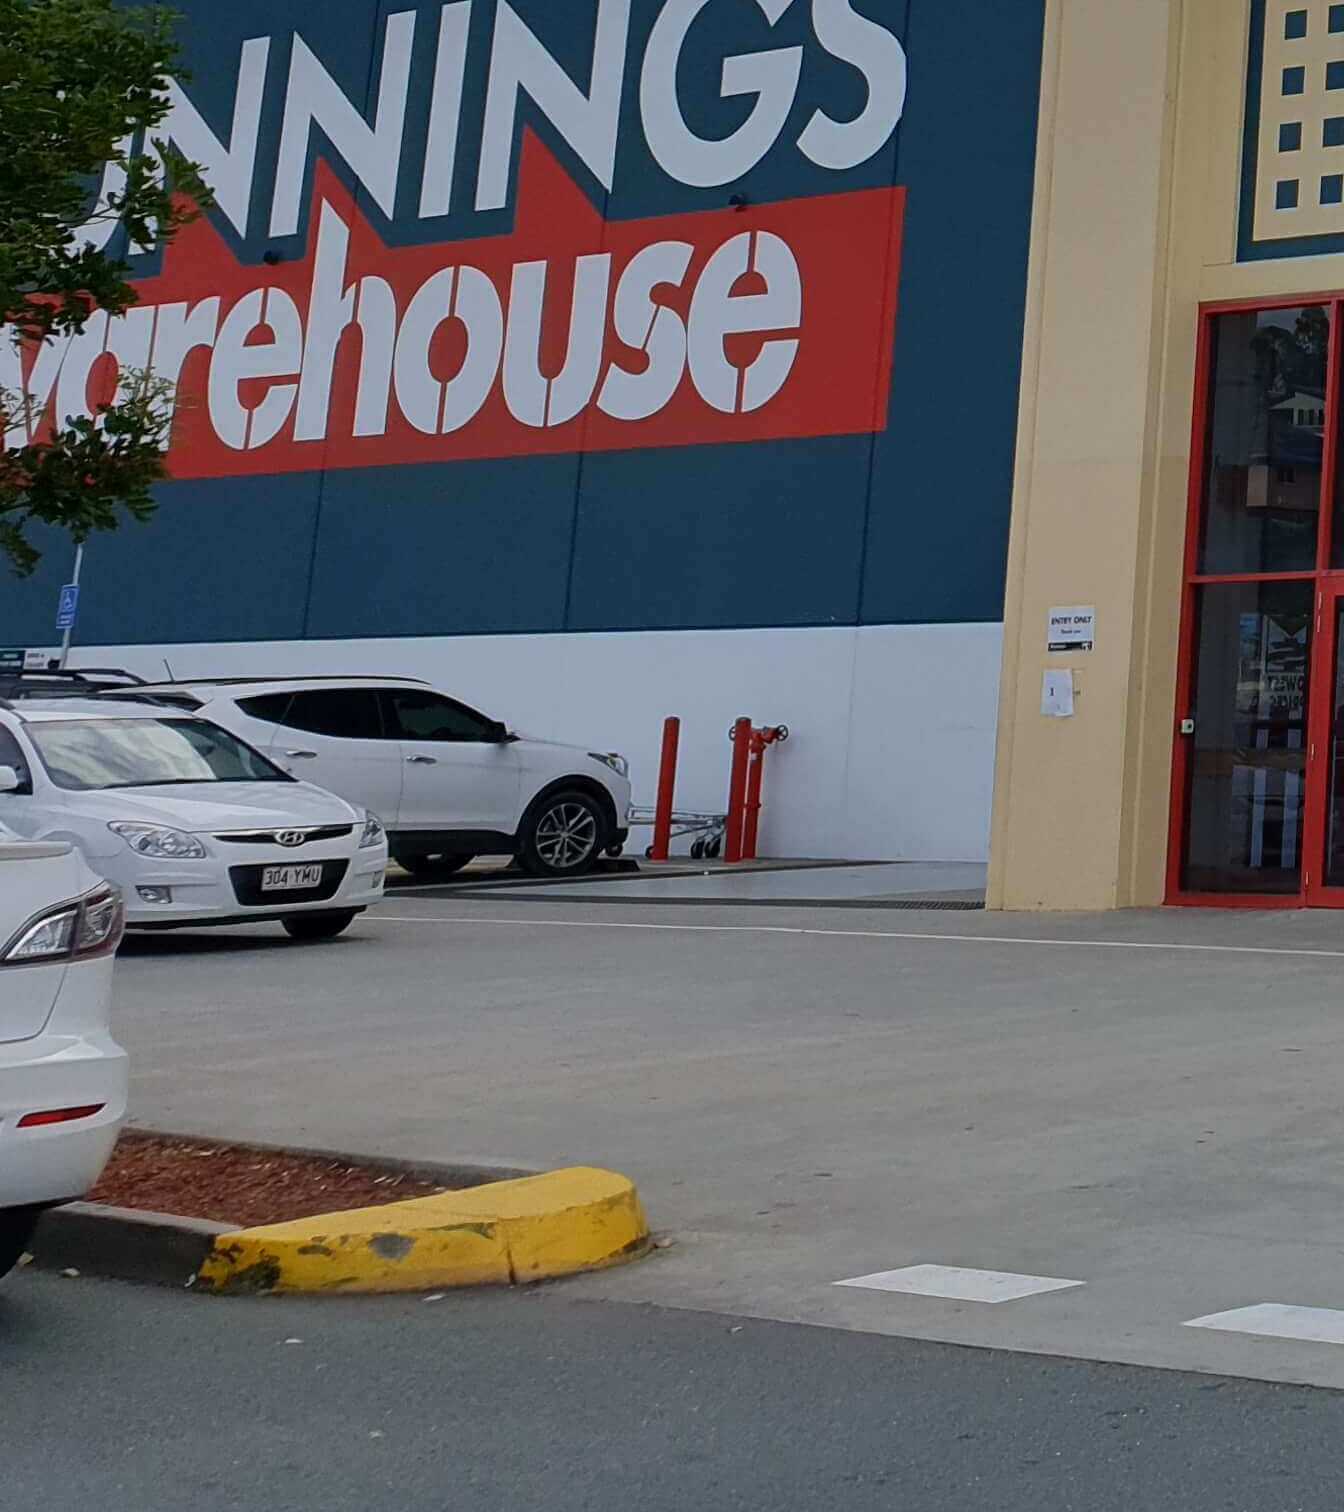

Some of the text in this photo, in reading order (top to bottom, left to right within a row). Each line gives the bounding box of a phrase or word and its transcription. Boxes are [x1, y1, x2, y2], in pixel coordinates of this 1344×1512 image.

[1073, 616, 1092, 624] ONLY
[264, 868, 320, 885] 304 YMU
